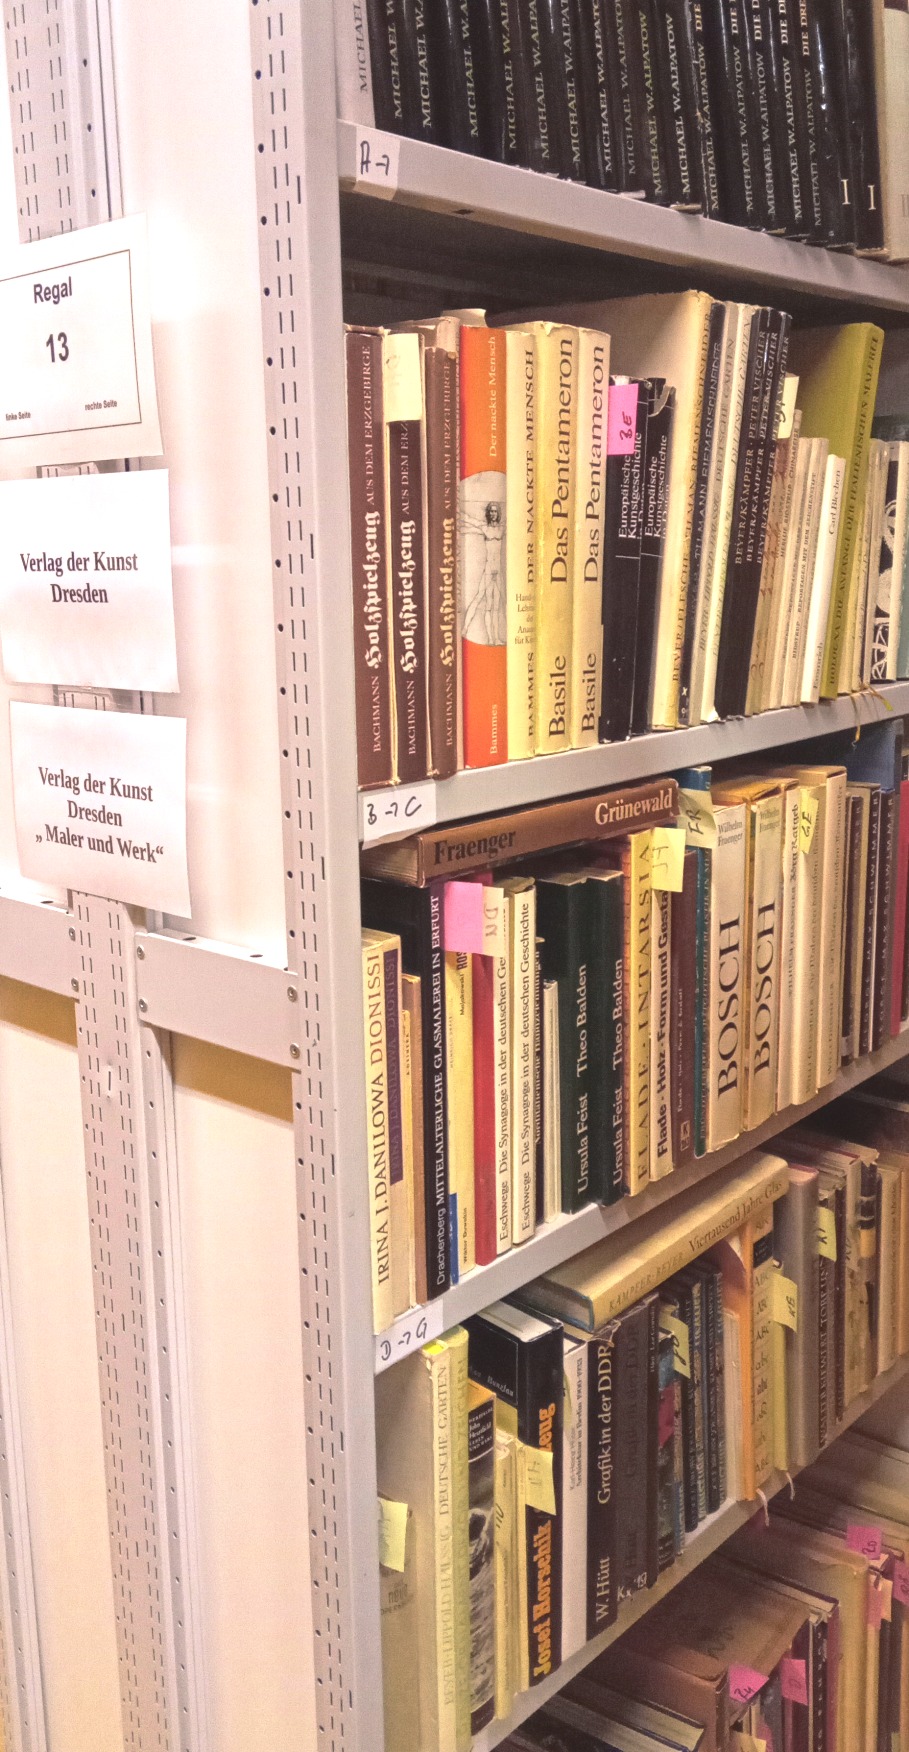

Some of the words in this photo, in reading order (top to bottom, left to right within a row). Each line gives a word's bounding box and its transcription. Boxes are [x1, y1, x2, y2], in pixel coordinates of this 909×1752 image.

[353, 4, 368, 92] MICHAEL
[730, 7, 739, 35] DIE
[753, 14, 763, 41] DIE
[780, 19, 789, 45] DIE
[802, 31, 811, 57] DIE
[388, 22, 403, 119] MICHAEL
[417, 33, 432, 128] MICHAEL
[464, 44, 479, 138] MICHAEL
[639, 10, 654, 112] W.ALPATOW
[666, 13, 681, 112] W.ALPATOW
[697, 42, 713, 135] W.ALPATOW
[733, 45, 747, 138] W.ALPATOW
[504, 59, 518, 149] MICHAEL
[535, 72, 550, 159] MICHAEL
[566, 78, 581, 164] MICHAEL
[756, 51, 770, 142] W.ALPATOW
[782, 56, 796, 146] W.ALPATOW
[599, 88, 613, 173] MICHAEL
[623, 94, 635, 175] MICHAEL
[649, 115, 663, 196] MICHAEL
[676, 115, 691, 195] MICHAEL
[707, 137, 720, 211] MICHAEL
[741, 138, 754, 214] MICHAEL
[763, 143, 776, 216] MICHAEL
[790, 148, 803, 221] MICHAEL
[810, 155, 822, 226] MICHAEL
[33, 276, 73, 305] Regal
[46, 332, 70, 363] 13
[487, 334, 498, 388] Mensch
[752, 330, 766, 390] VISCHER
[762, 331, 778, 390] VISCHER
[85, 401, 103, 411] rechte
[103, 399, 118, 410] Seite
[362, 344, 374, 437] ERZGEBIRGE
[442, 362, 451, 449] ERZGEBIRGE
[488, 390, 498, 428] nackte
[524, 348, 535, 442] MENSCH
[747, 394, 760, 439] PETER
[758, 394, 771, 440] PETER
[488, 428, 498, 458] Der
[551, 338, 574, 521] Pentameron
[584, 346, 605, 522] Pentameron
[365, 446, 374, 488] DEM
[366, 488, 376, 506] AUS
[401, 454, 409, 488] DEM
[526, 449, 535, 535] NACKTE
[618, 455, 632, 538] Europäische
[627, 432, 643, 540] Kunstgeschichte
[644, 456, 658, 538] Europäische
[653, 434, 668, 539] Kunstgeschichte
[401, 489, 411, 515] AUS
[444, 486, 452, 511] AUS
[20, 551, 64, 577] Verlag
[67, 551, 90, 571] der
[93, 551, 139, 571] Kunst
[526, 542, 535, 584] DER
[550, 526, 569, 584] Das
[583, 526, 600, 583] Das
[50, 582, 109, 603] Dresden
[372, 675, 382, 753] BACHMANN
[407, 680, 417, 755] BACHMANN
[446, 673, 454, 747] BACHMANN
[527, 651, 535, 737] BAMMES
[548, 655, 567, 738] Basile
[581, 652, 597, 734] Basile
[490, 703, 499, 755] Bammes
[38, 766, 80, 796] Verlag
[84, 772, 106, 794] der
[109, 777, 153, 802] Kunst
[67, 800, 122, 827] Dresden
[45, 824, 84, 848] Maler
[87, 835, 114, 855] und
[432, 829, 517, 865] Fraenger
[595, 788, 674, 825] Grünewald
[718, 819, 743, 834] Wilhelm
[718, 831, 743, 847] Fraenger
[431, 895, 441, 950] ERFURT
[520, 903, 530, 974] Geschichte
[432, 953, 441, 970] IN
[612, 958, 623, 1022] Balden
[657, 951, 668, 986] und
[753, 901, 776, 1078] BOSCH
[367, 953, 383, 1067] DIONISSI
[432, 971, 443, 1070] GLASMALEREI
[498, 980, 507, 1046] deutschen
[520, 975, 530, 1040] deutschen
[576, 963, 587, 1028] Balden
[657, 991, 668, 1043] Form
[718, 913, 740, 1100] BOSCH
[498, 1049, 507, 1071] der
[521, 1044, 530, 1065] der
[521, 1065, 530, 1080] in
[576, 1028, 588, 1078] Theo
[612, 1022, 623, 1071] Theo
[656, 1043, 668, 1094] Holz
[499, 1073, 507, 1083] in
[612, 1085, 623, 1128] Feist
[433, 1072, 446, 1207] MITTELALTERLICHE
[498, 1084, 509, 1148] Synagoge
[521, 1080, 531, 1147] Synagoge
[577, 1092, 588, 1135] Feist
[657, 1102, 668, 1159] Flade
[498, 1150, 508, 1175] Die
[521, 1148, 530, 1166] Die
[577, 1137, 589, 1195] Ursula
[612, 1129, 624, 1187] Ursula
[499, 1181, 508, 1241] Eschwege
[522, 1171, 530, 1232] Eschwege
[688, 1209, 740, 1253] Viertausend
[740, 1197, 763, 1223] Jahre
[765, 1179, 783, 1200] Glas
[376, 1220, 389, 1286] IRINA
[437, 1207, 447, 1286] Drachenberg
[597, 1345, 613, 1393] DDR
[599, 1396, 612, 1424] der
[599, 1427, 611, 1446] in
[438, 1437, 449, 1516] DEUTSCHE
[597, 1450, 613, 1505] Grafik
[533, 1519, 551, 1621] Horschik
[597, 1556, 610, 1596] Hütt
[596, 1597, 609, 1622] W.
[533, 1620, 551, 1678] Josef
